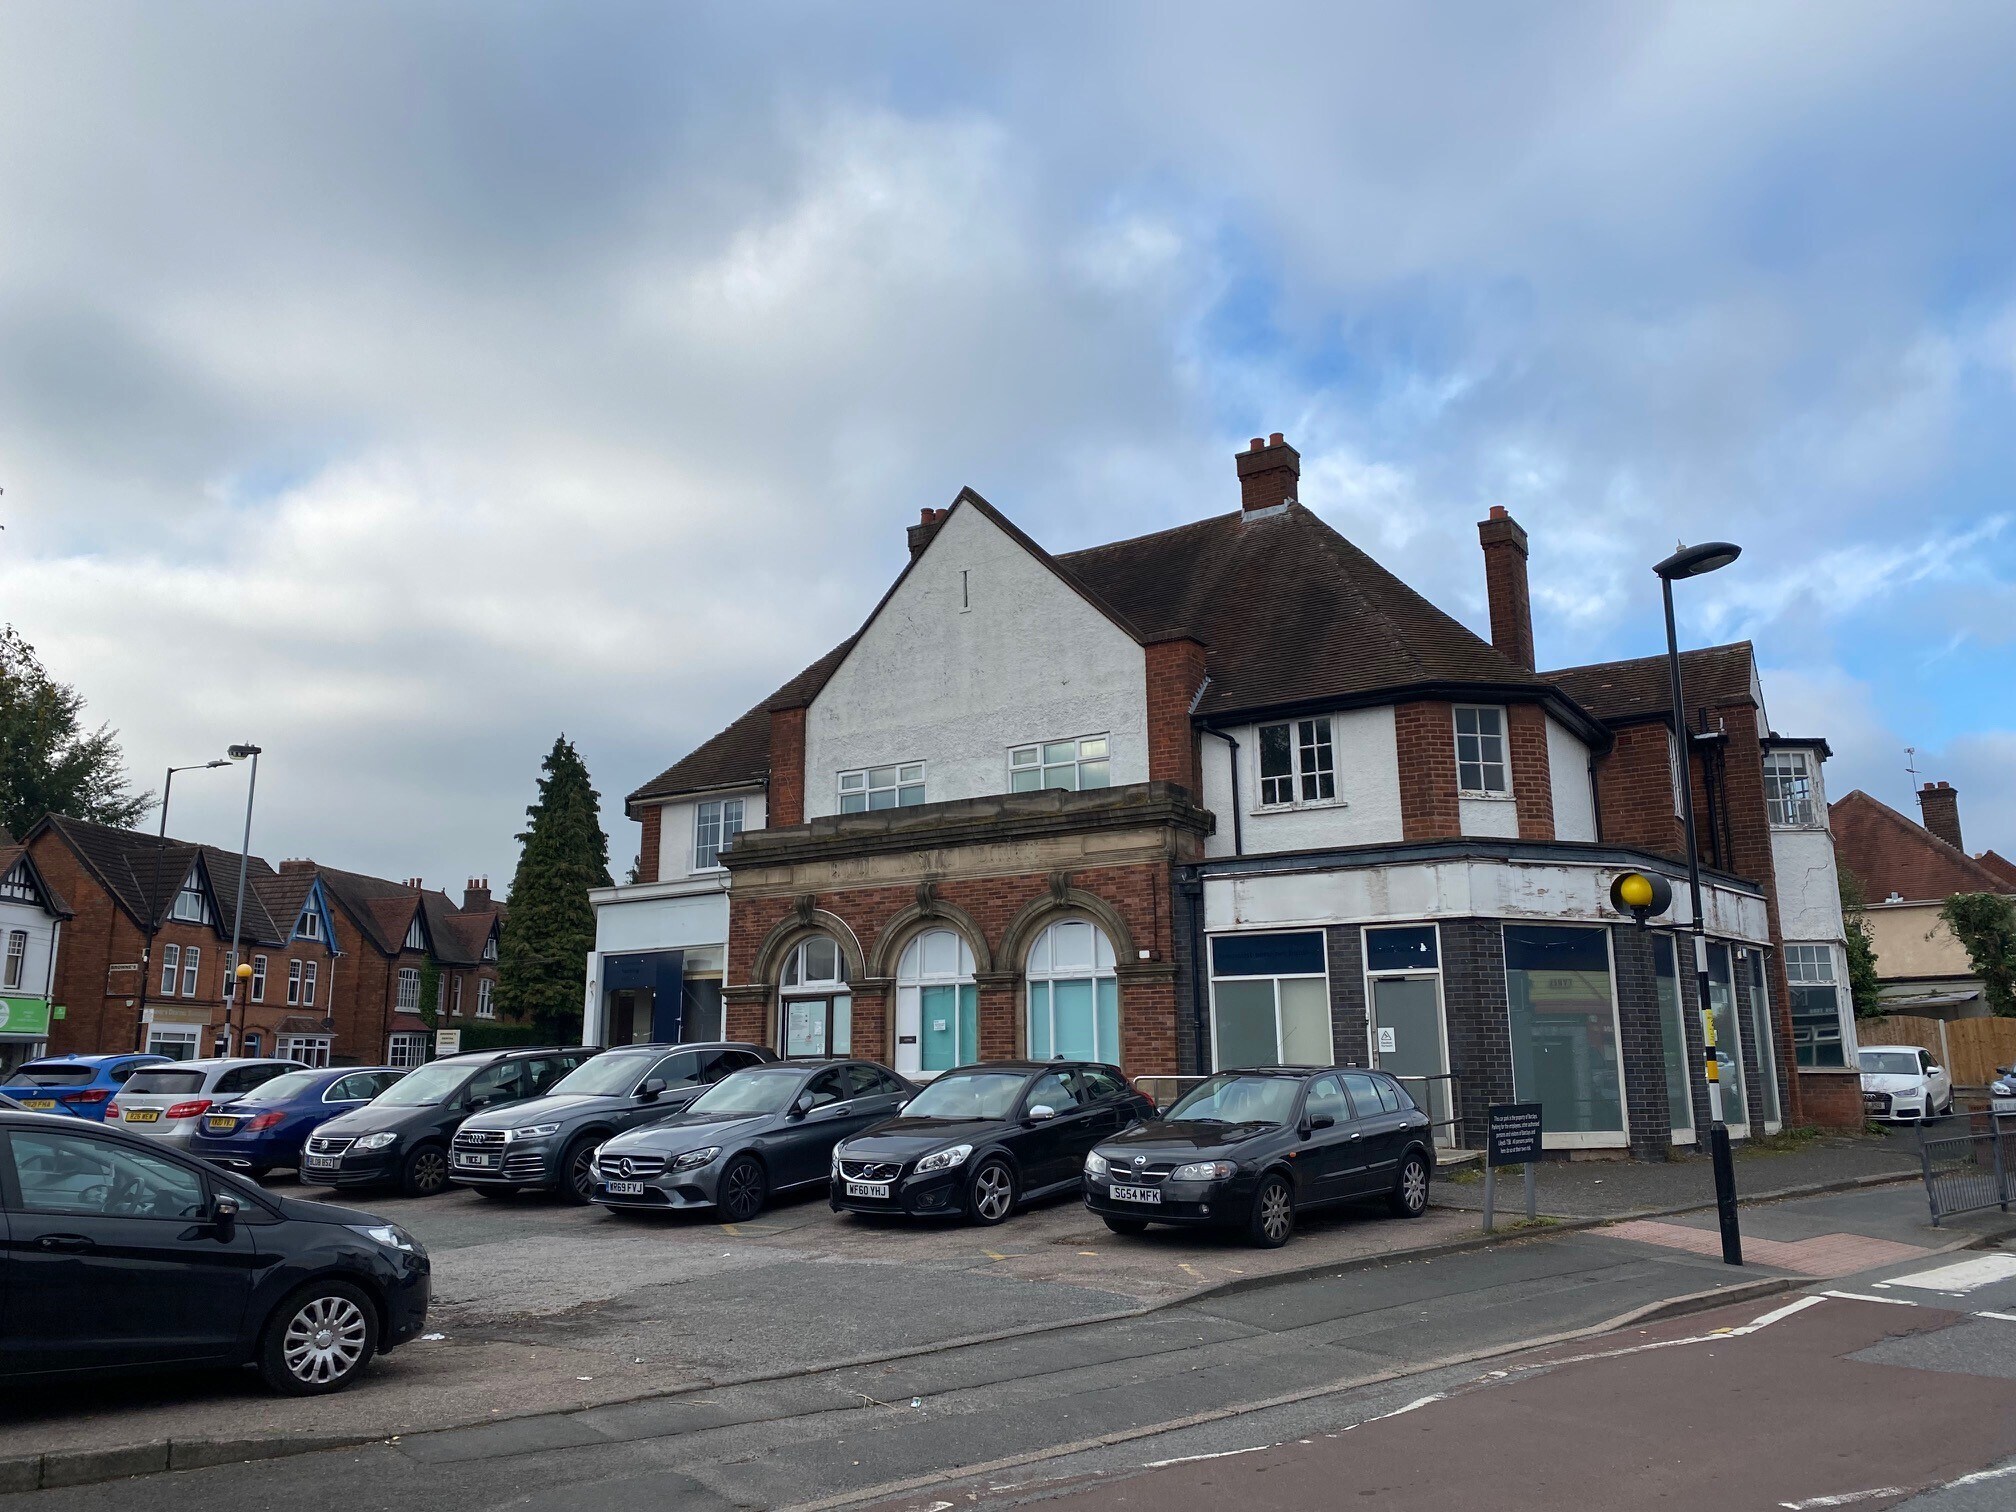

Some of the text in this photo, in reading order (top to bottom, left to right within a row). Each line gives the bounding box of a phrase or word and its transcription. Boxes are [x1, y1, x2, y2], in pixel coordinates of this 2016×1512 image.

[610, 1182, 626, 1192] WR69
[850, 1185, 886, 1196] WF60 YHJ
[1115, 1187, 1159, 1201] SG54 MFK
